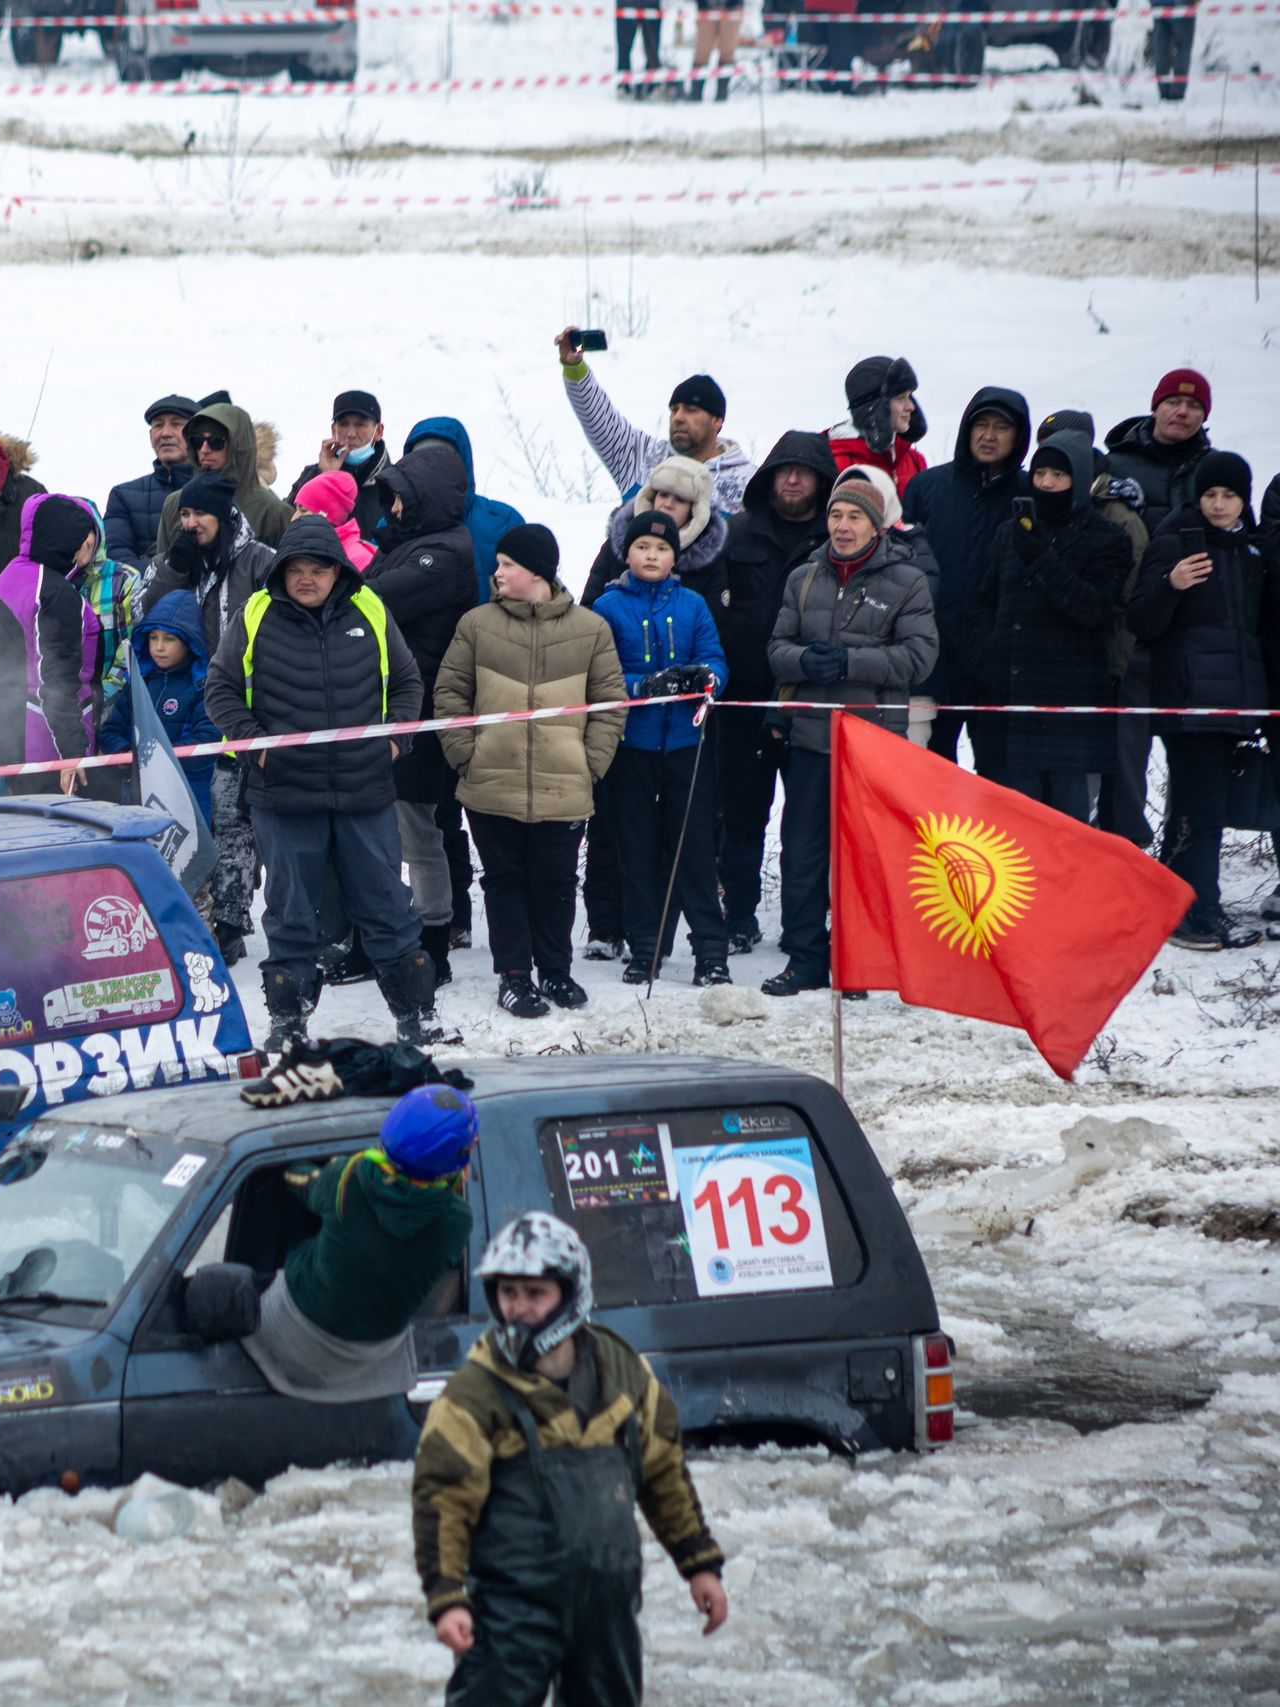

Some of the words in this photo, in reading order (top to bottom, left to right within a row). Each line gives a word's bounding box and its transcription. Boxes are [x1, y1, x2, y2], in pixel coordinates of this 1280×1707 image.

[72, 983, 96, 998] LIS
[99, 973, 161, 993] TRUCKS
[82, 984, 156, 1008] COMPANY
[565, 1149, 619, 1180] 201
[693, 1174, 811, 1250] 113
